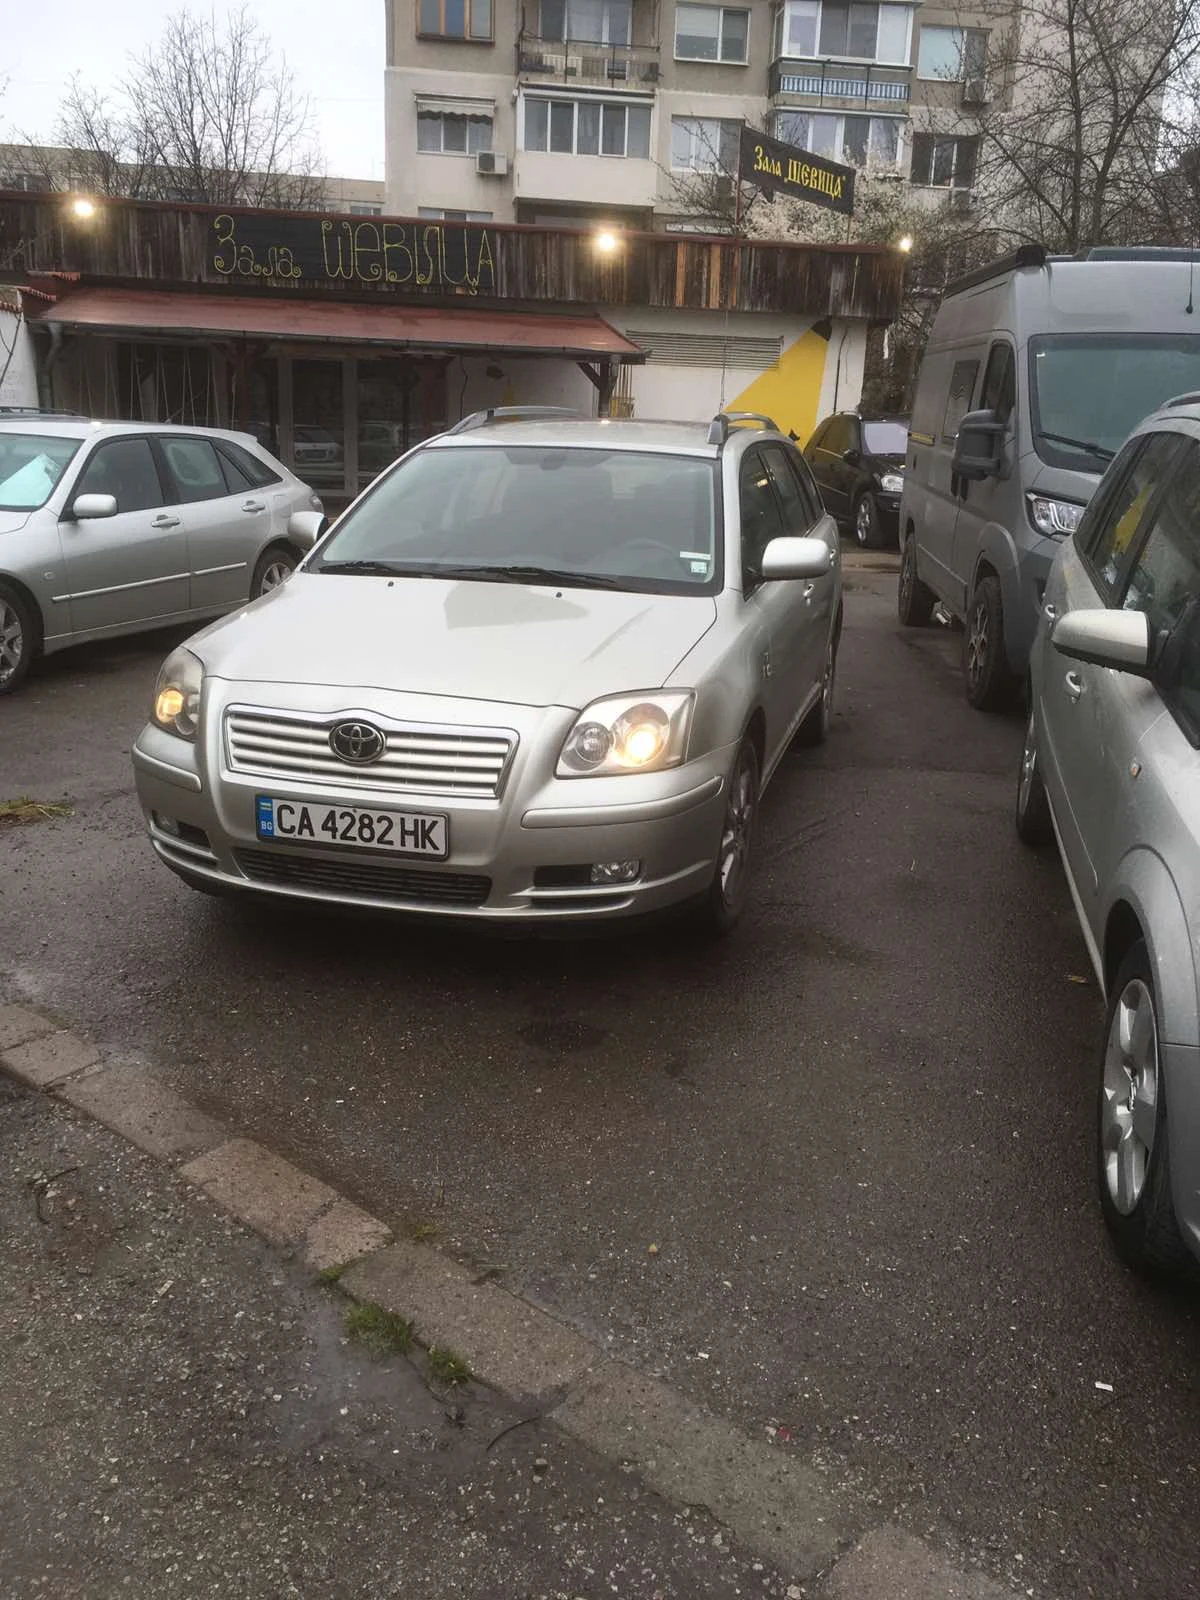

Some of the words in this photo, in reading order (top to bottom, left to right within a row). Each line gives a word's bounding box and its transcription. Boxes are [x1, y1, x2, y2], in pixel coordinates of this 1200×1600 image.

[753, 145, 782, 177] Зала
[213, 214, 302, 279] Зала
[261, 820, 273, 831] BG
[276, 804, 315, 838] CA
[321, 809, 394, 846] 4282
[400, 817, 440, 851] HK
